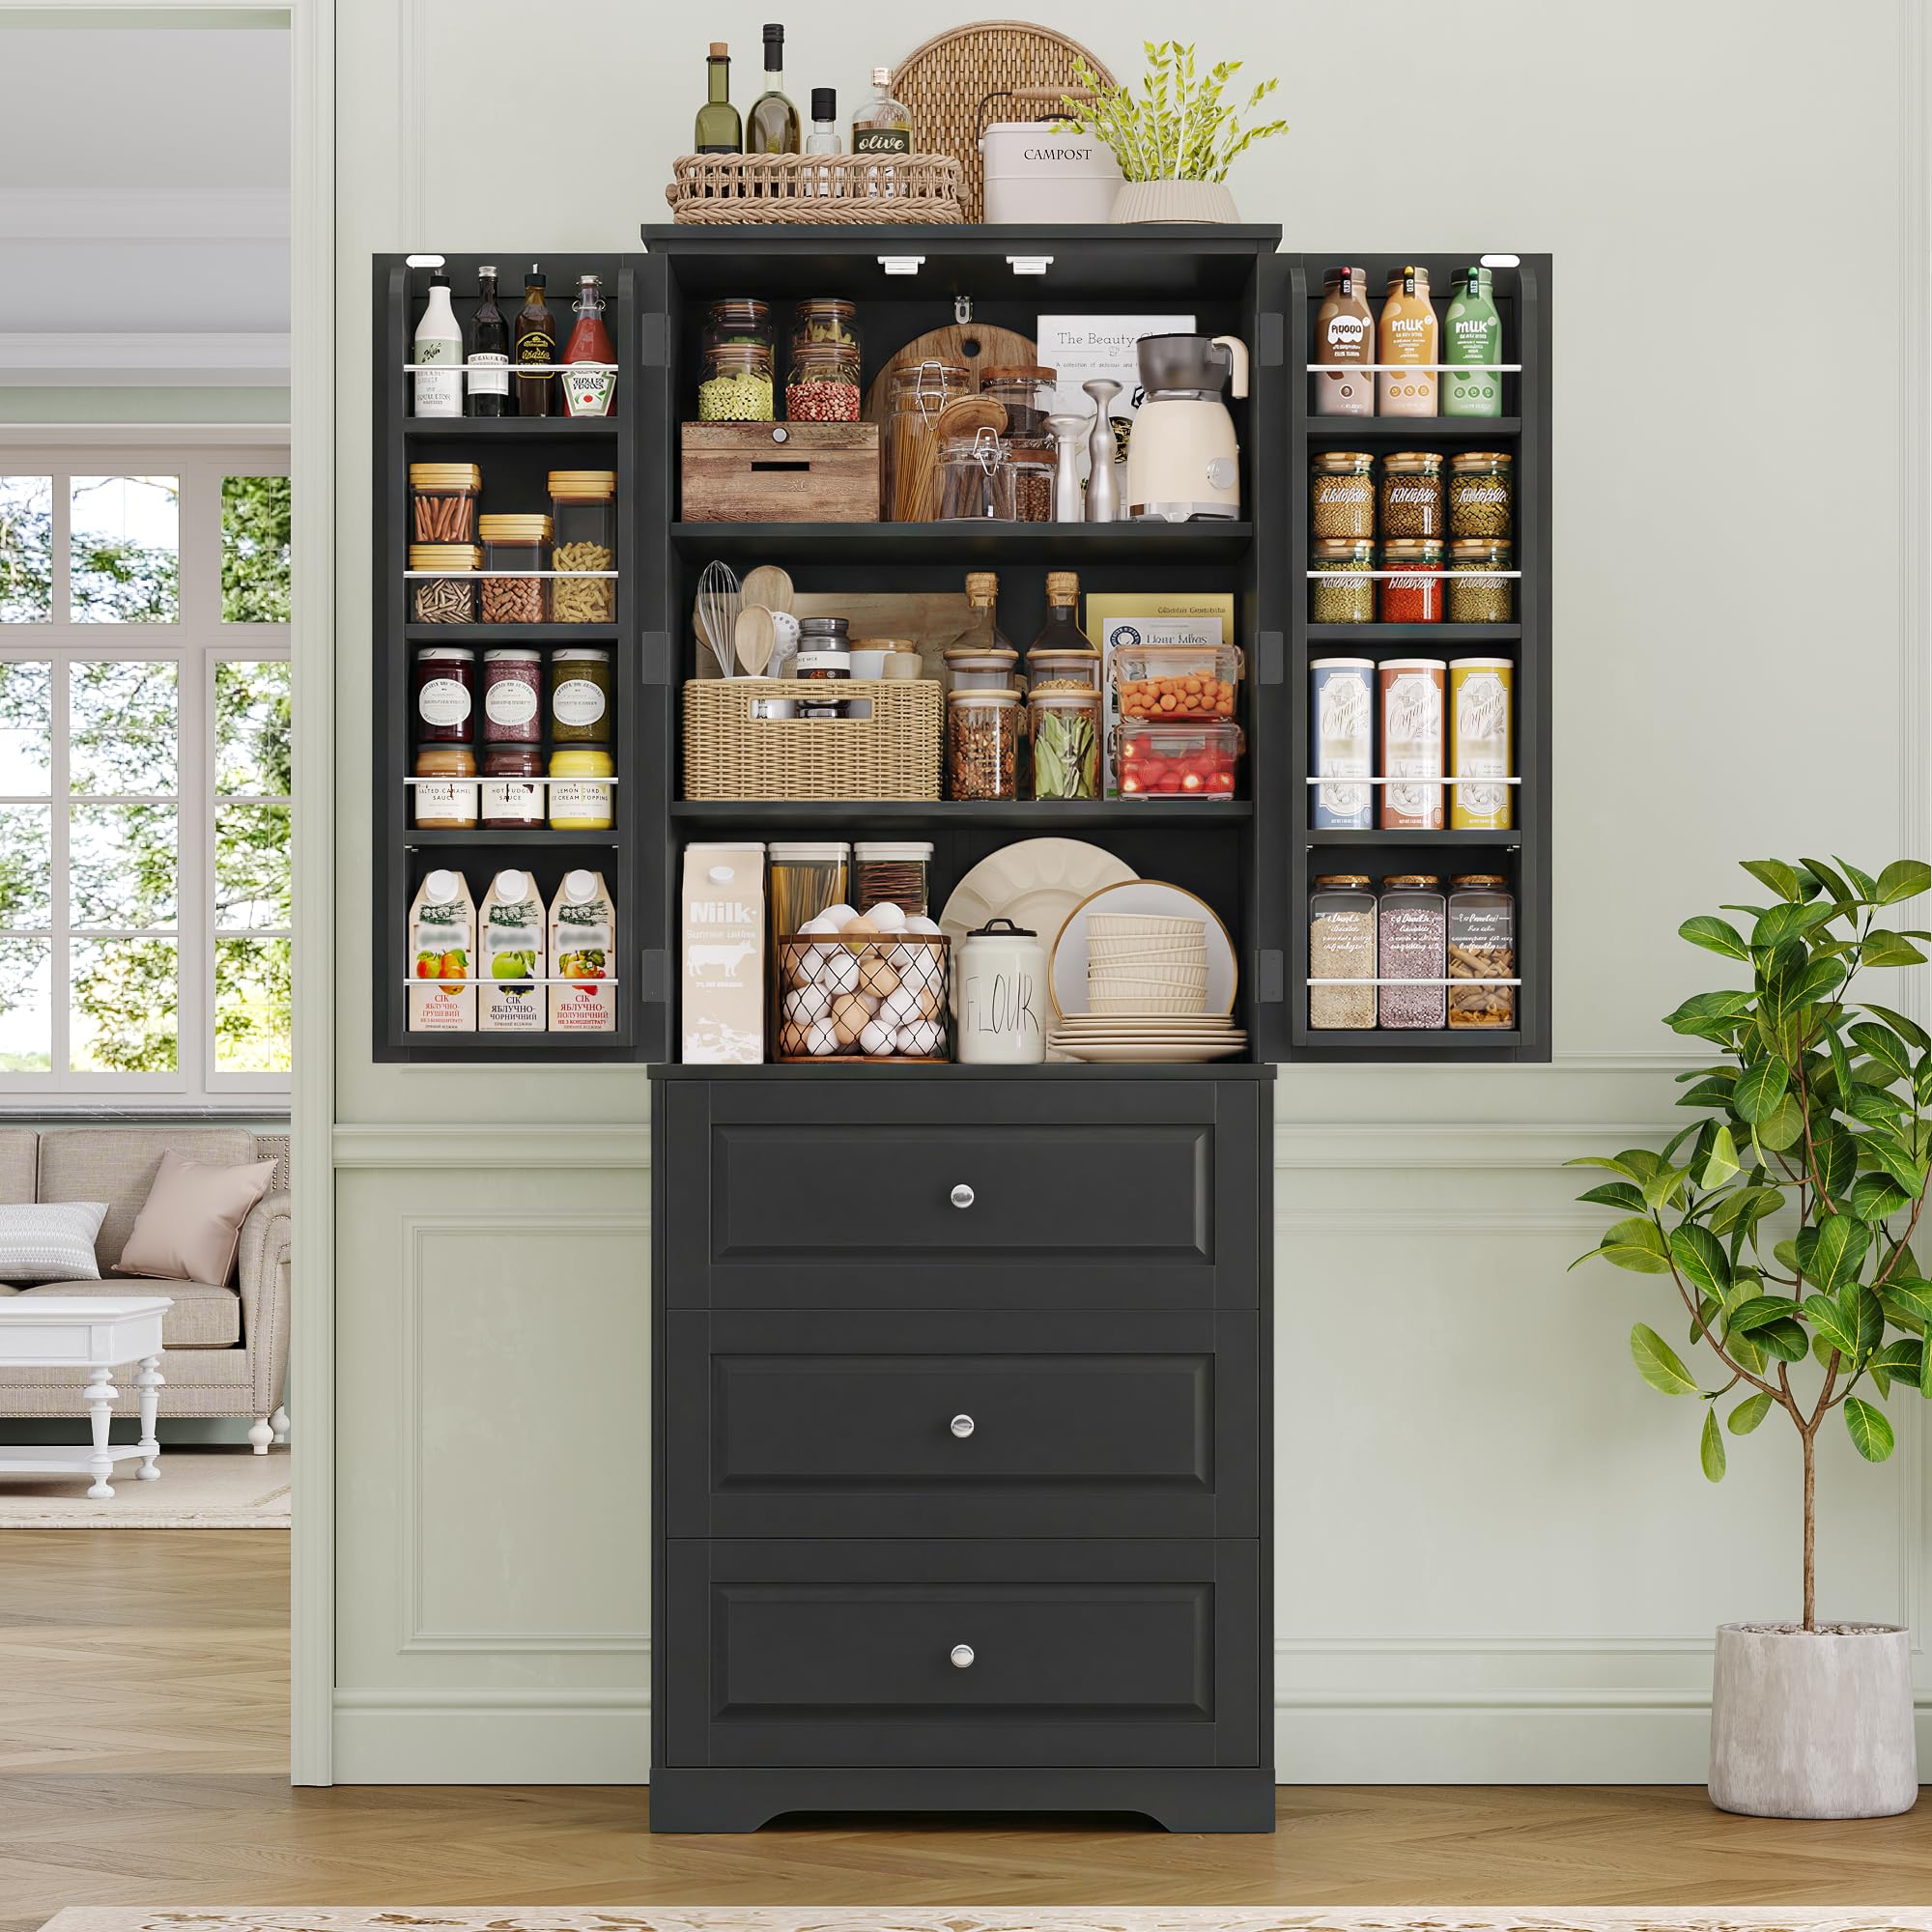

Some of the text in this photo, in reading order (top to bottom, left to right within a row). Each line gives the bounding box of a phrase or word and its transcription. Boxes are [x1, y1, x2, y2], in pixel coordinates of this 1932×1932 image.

[858, 132, 905, 151] olive
[1024, 149, 1093, 161] CAMPOST
[1057, 331, 1083, 345] The
[1088, 332, 1135, 348] Beauty
[690, 901, 753, 923] Milk
[434, 994, 449, 1003] СІК
[505, 996, 522, 1005] СІК
[575, 994, 590, 1003] СІК
[965, 972, 1039, 1035] FLOUR
[491, 1005, 537, 1013] ЯБЛУЧНО-
[560, 1003, 605, 1011] ЯБЛУЧНО-
